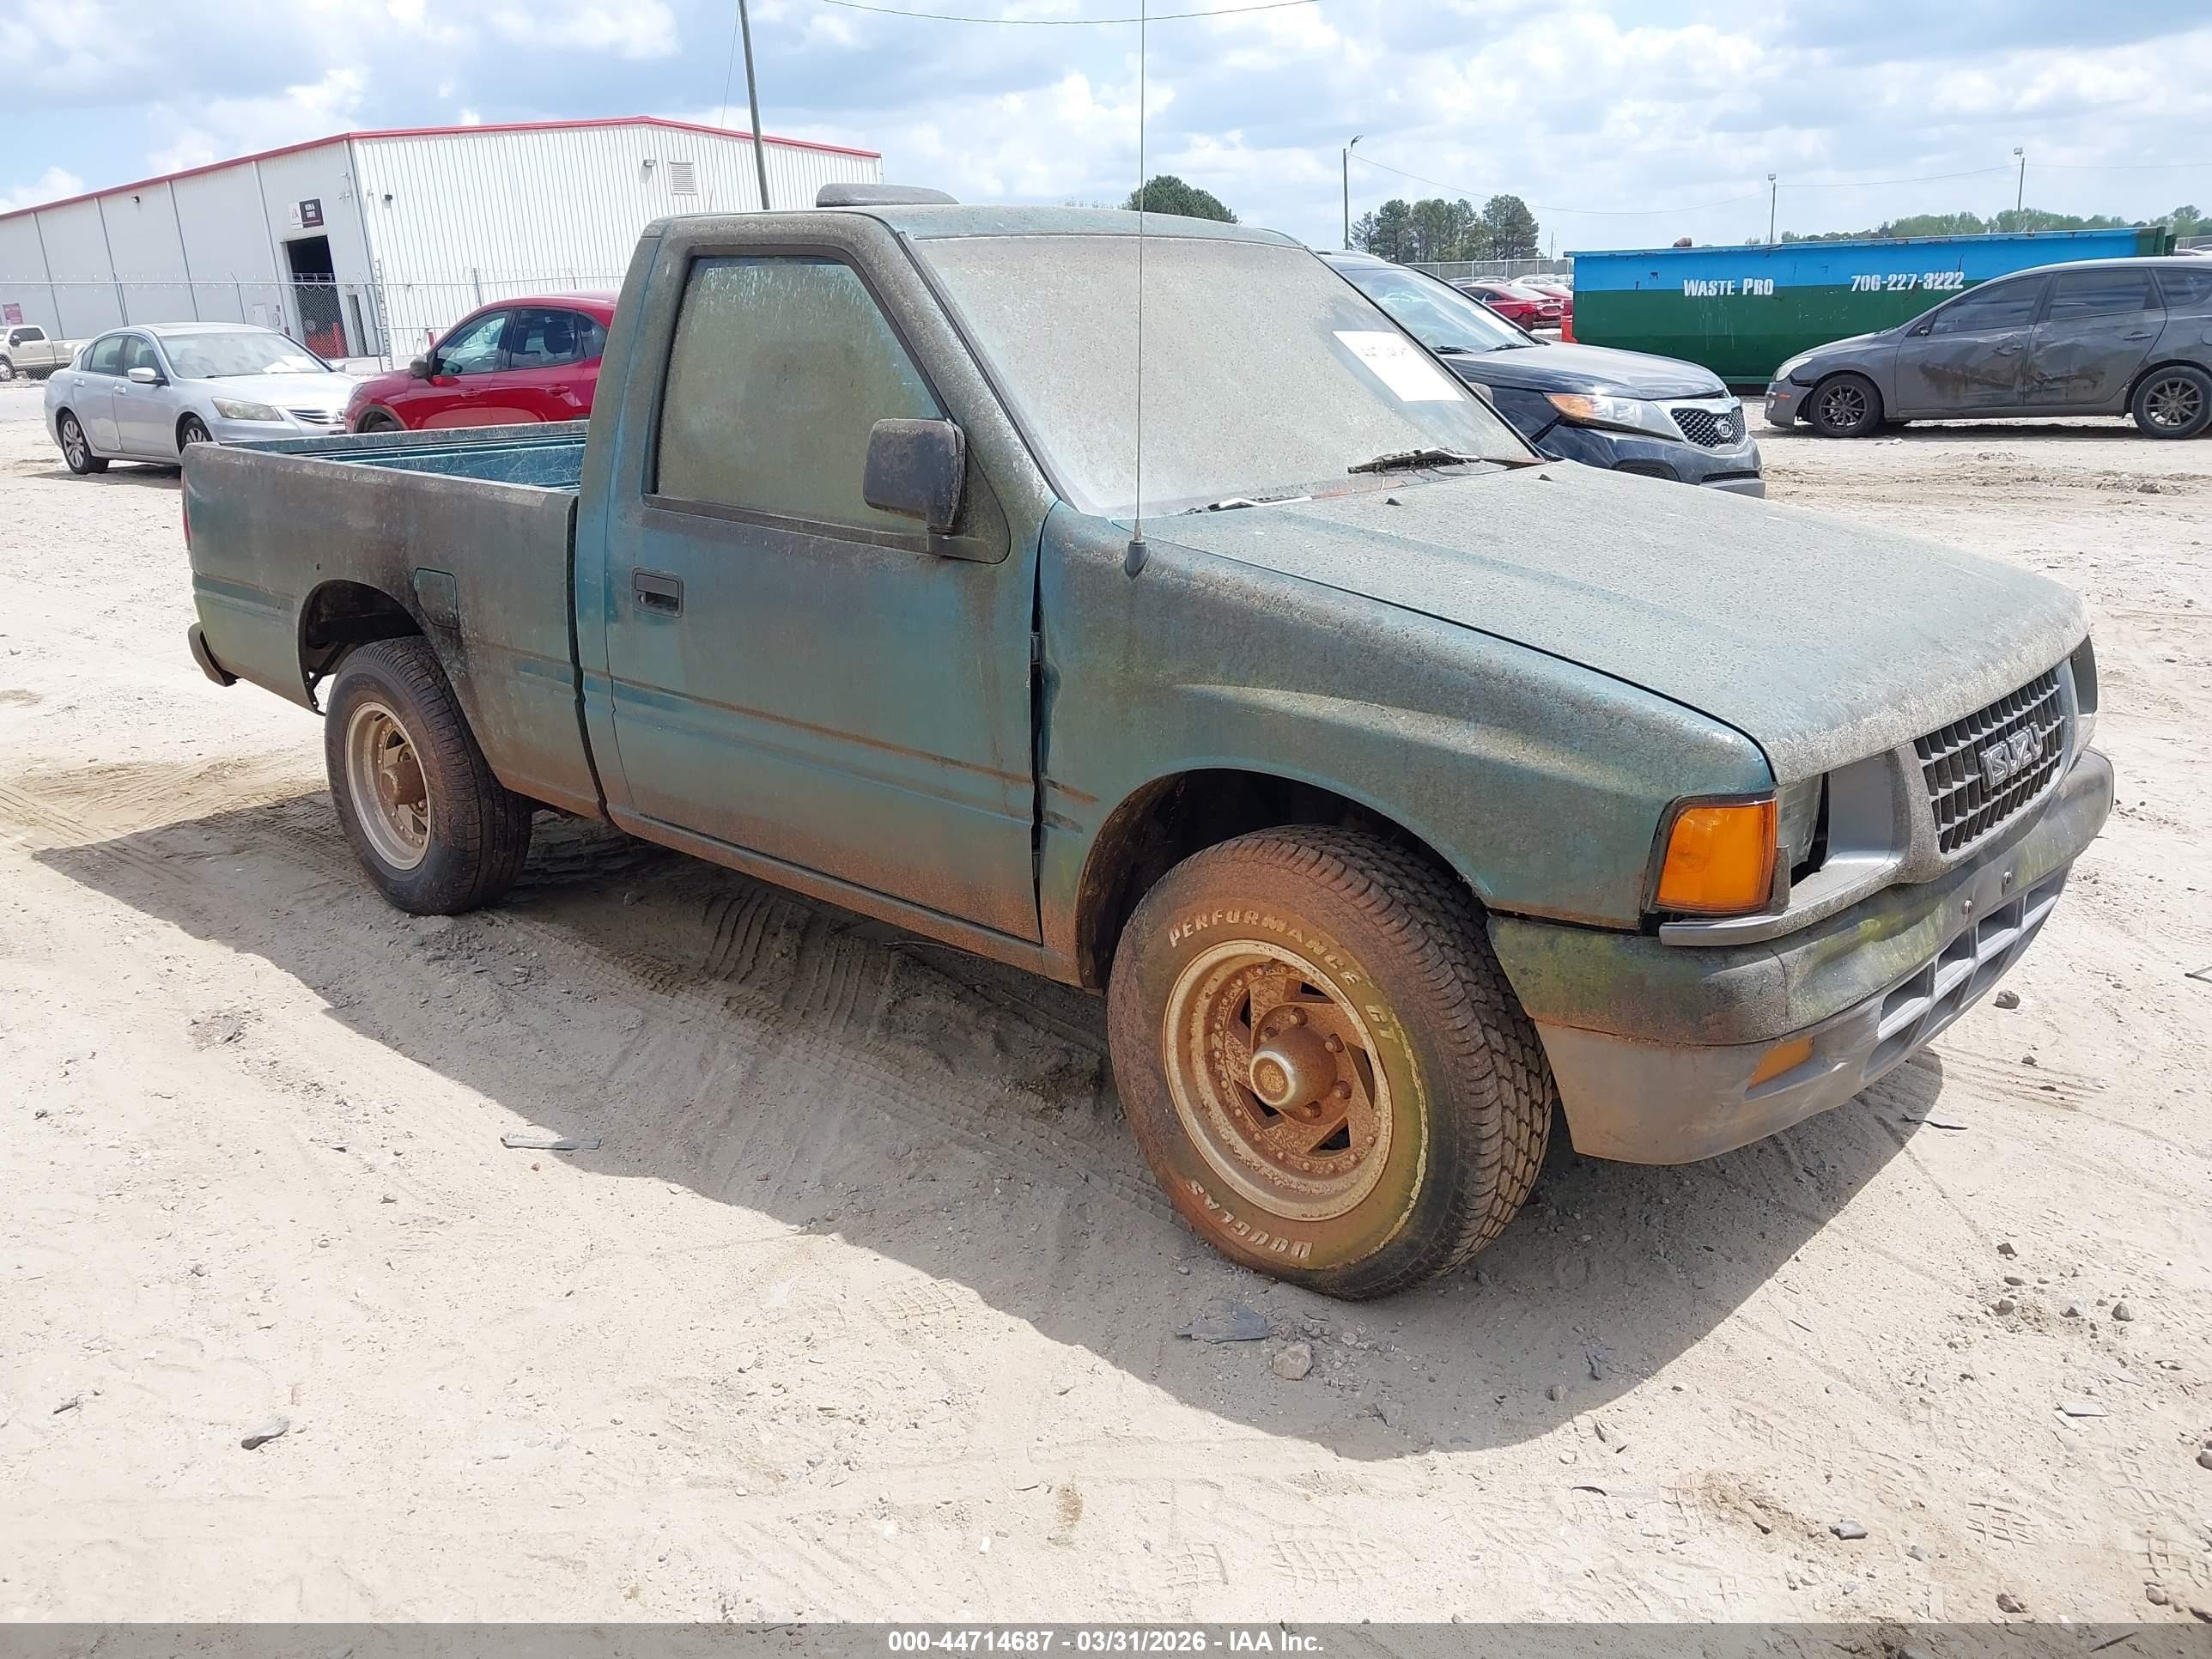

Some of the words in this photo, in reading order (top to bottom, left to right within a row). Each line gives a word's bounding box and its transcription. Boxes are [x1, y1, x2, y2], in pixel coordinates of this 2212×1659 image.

[1683, 278, 1735, 296] WASTE
[1742, 277, 1774, 296] PRO
[1850, 271, 1965, 292] 706-227-3222
[1979, 721, 2044, 793] ISUZU
[1167, 908, 1362, 986] PERFORMANCE
[1364, 1004, 1401, 1045] GT
[1186, 1180, 1313, 1260] DOUGLAS
